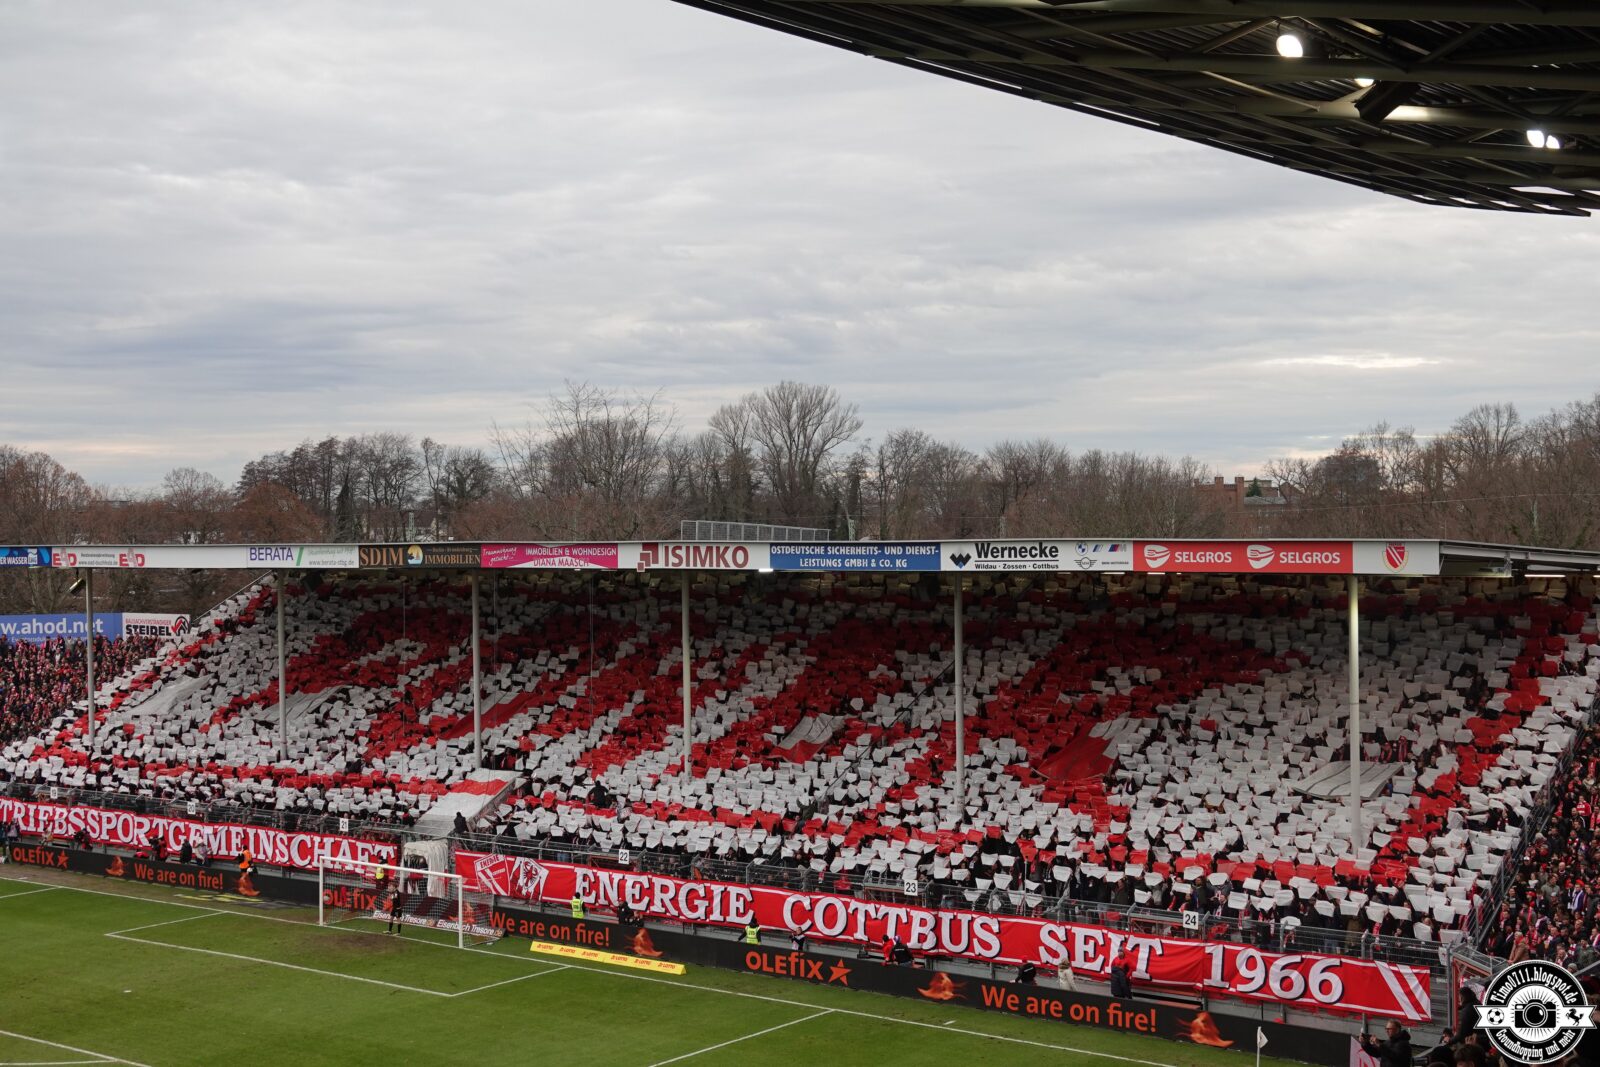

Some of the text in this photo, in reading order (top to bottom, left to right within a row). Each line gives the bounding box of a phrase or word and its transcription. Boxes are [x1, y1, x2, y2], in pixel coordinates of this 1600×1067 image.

[249, 547, 294, 561] BERATA
[360, 547, 404, 566] SDIM
[525, 547, 617, 556] IMMOBILIEN & WOHNDESIGN
[664, 545, 749, 568] ISIMKO
[771, 545, 939, 555] OSTDEUTSCHE SICHERHEITS- UND DIENST-
[974, 542, 1059, 559] Wernecke
[7, 557, 28, 565] WASSER
[424, 554, 480, 565] IMMOBILIEN
[533, 557, 590, 567] DIANA MAASCH
[800, 559, 908, 568] LEISTUNGS GMBH & CO. KG
[1174, 551, 1232, 563] SELGROS
[1279, 551, 1341, 564] SELGROS
[125, 624, 172, 637] STEIDEL
[341, 820, 348, 830] 21
[12, 848, 55, 866] OLEfix
[619, 853, 631, 864] 22
[134, 863, 224, 891] We are on fire!
[905, 882, 917, 894] 23
[1183, 913, 1197, 926] 24
[488, 911, 610, 948] We are on fire!
[574, 867, 1344, 1004] ENERGIE COTTBUS SEIT 1966
[745, 951, 825, 981] OLEfix
[981, 984, 1157, 1033] We are on fire!
